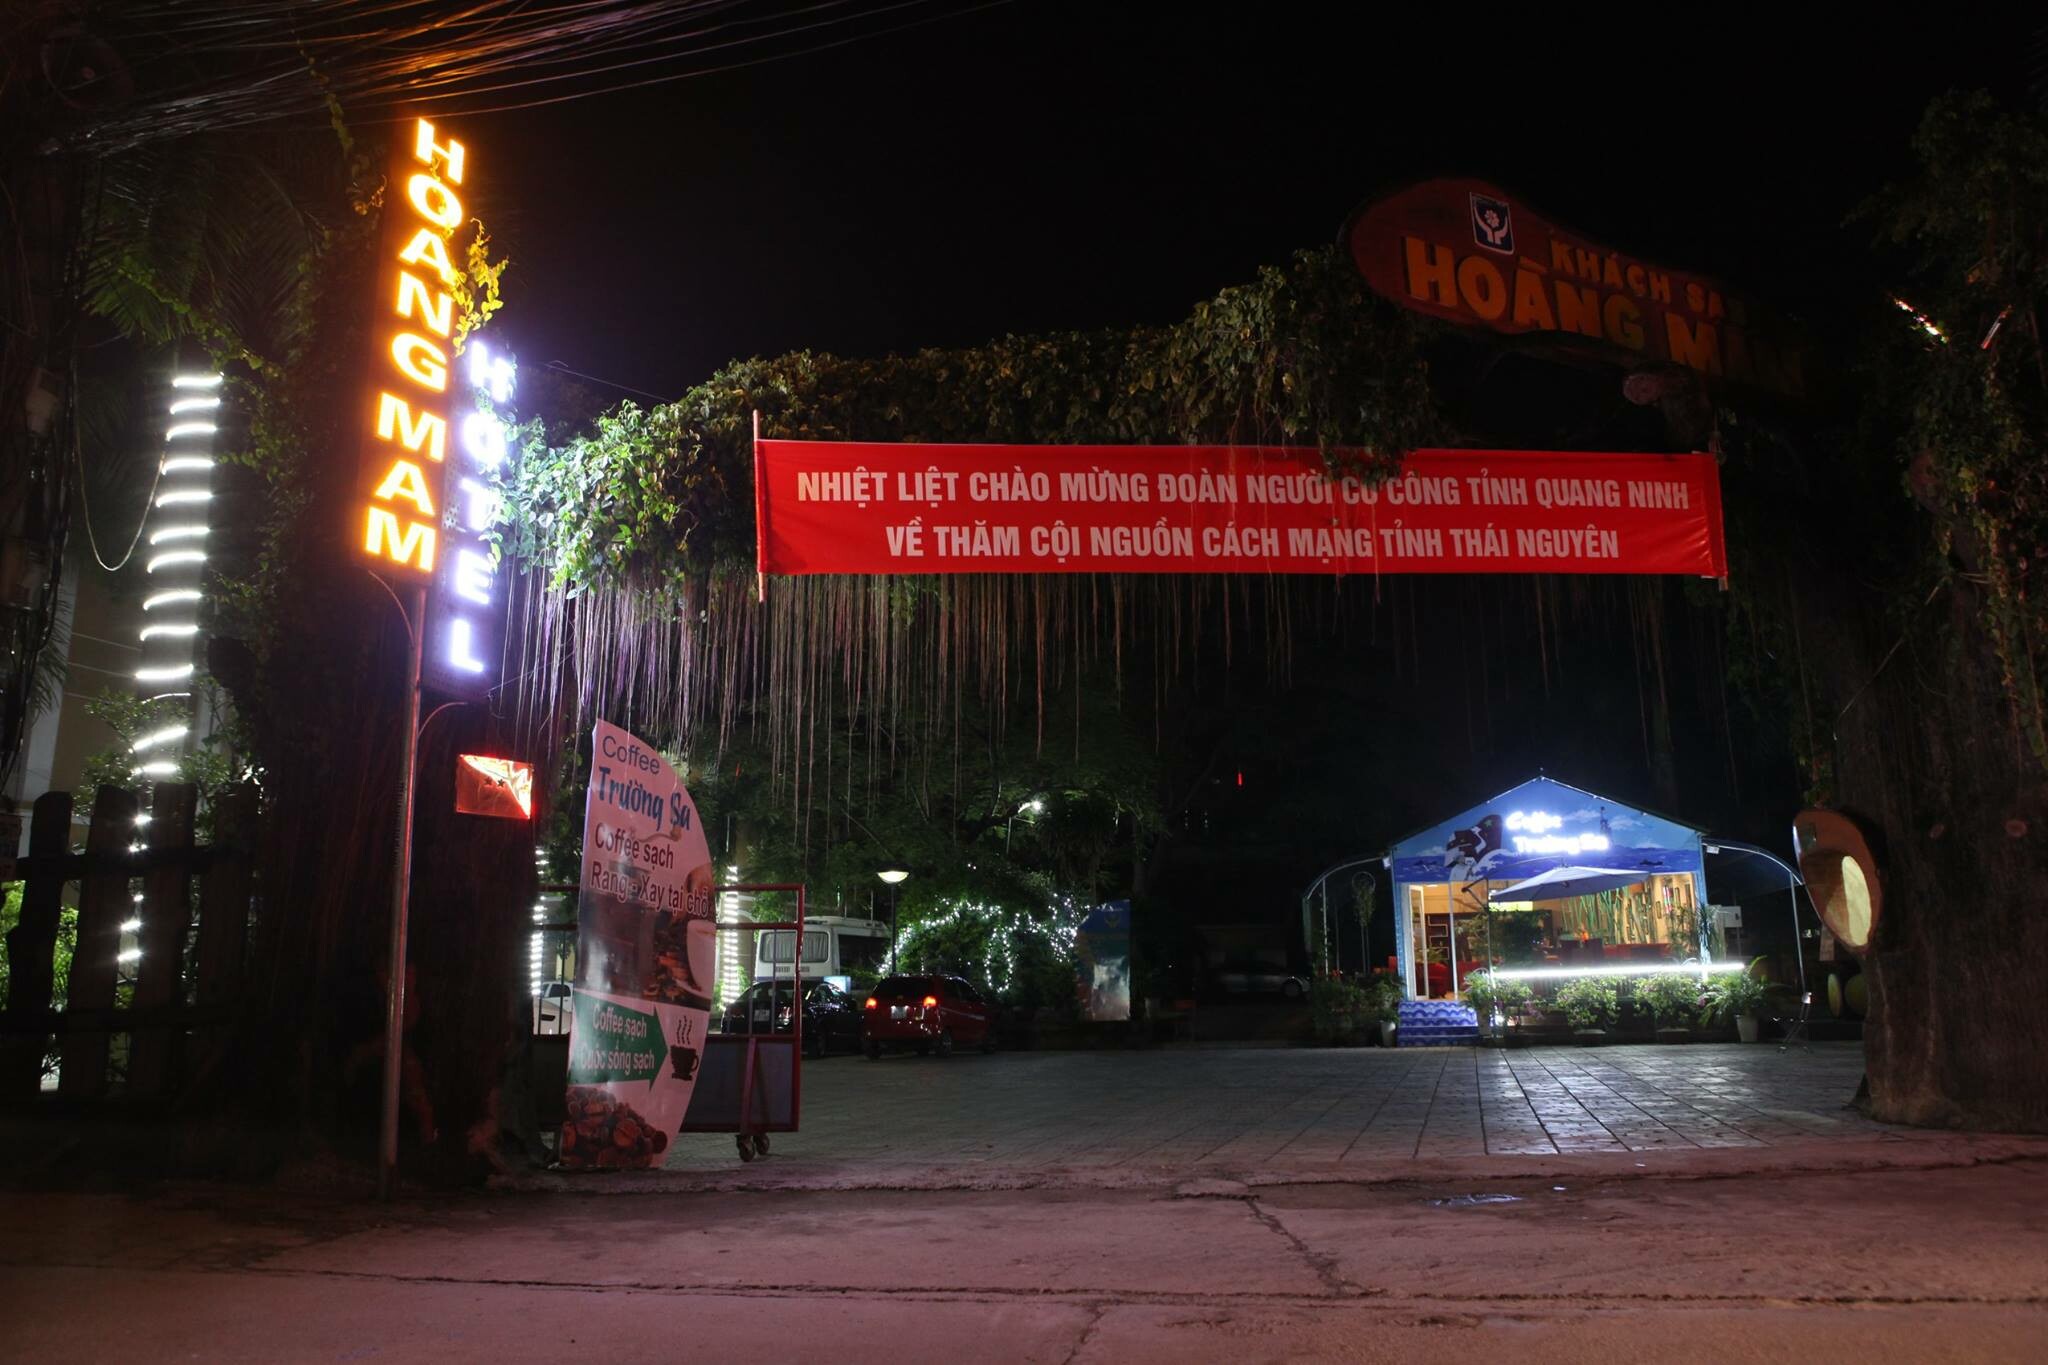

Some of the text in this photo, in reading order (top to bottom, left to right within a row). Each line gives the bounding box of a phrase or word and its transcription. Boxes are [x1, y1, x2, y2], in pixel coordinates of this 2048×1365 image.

[1402, 234, 1645, 351] HOÀNG
[1550, 239, 1672, 305] KHÁCH
[363, 118, 465, 573] HOANG MAM
[450, 340, 515, 673] HOTEL
[797, 466, 888, 508] NHIỆT
[898, 466, 959, 508] LIỆT
[969, 465, 1050, 502] CHÀO
[1060, 465, 1149, 503] MỪNG
[1157, 467, 1238, 503] ĐOÀN
[1246, 468, 1333, 504] NGƯỜI
[1386, 470, 1460, 505] CÔNG
[1466, 467, 1526, 506] TỈNH
[1535, 477, 1621, 509] QUANG
[1627, 480, 1690, 510] NINH
[886, 516, 1619, 564] VỀ THĂM CỘI NGUỒN CÁCH MẠNG TỈNH THÁI NGUYÊN
[602, 735, 661, 775] Coffee
[598, 766, 691, 831] Trường Sa
[595, 823, 674, 870] Coffee sạch
[591, 861, 629, 903] Rang
[640, 874, 665, 912] Xay
[668, 884, 684, 915] tại
[592, 1003, 647, 1041] Coffee sạch
[608, 1038, 631, 1076] sống
[633, 1049, 655, 1075] sạch
